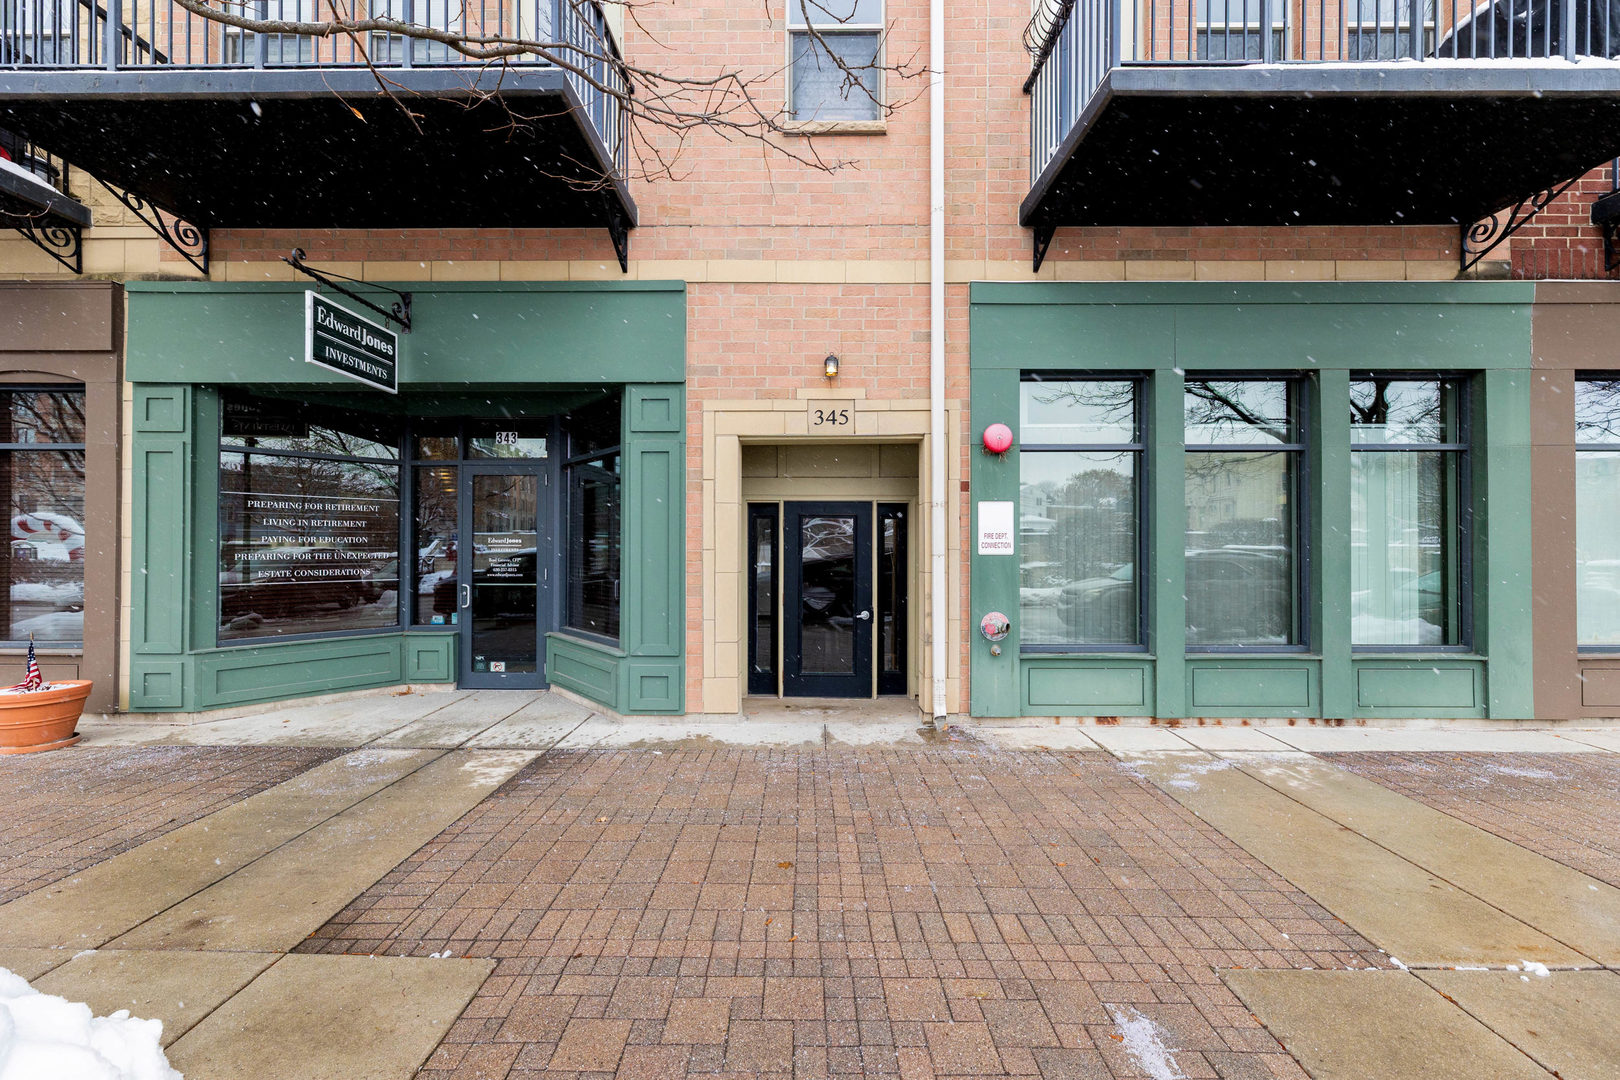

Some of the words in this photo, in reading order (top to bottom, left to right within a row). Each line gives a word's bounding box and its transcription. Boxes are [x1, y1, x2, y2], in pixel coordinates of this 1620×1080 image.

[325, 345, 388, 380] INVESTMENTS
[813, 409, 849, 426] 345
[496, 432, 517, 444] 343
[247, 500, 302, 509] PREPARING
[305, 502, 323, 510] FOR
[325, 503, 380, 512] RETIREMENT
[263, 518, 296, 526] LIVING
[298, 519, 309, 527] IN
[311, 519, 367, 528] RETIREMENT
[261, 535, 296, 543] PAYING
[298, 535, 317, 543] FOR
[319, 536, 368, 544] EDUCATION
[984, 532, 994, 540] FIRE
[995, 532, 1008, 540] DEPT.
[981, 541, 1012, 549] CONNECTION
[234, 553, 290, 561] PREPARING
[293, 552, 312, 560] FOR
[314, 552, 332, 560] THE
[334, 551, 389, 560] UNEXPECTED
[258, 570, 293, 578] ESTATE
[294, 568, 371, 577] CONSIDERATIONS
